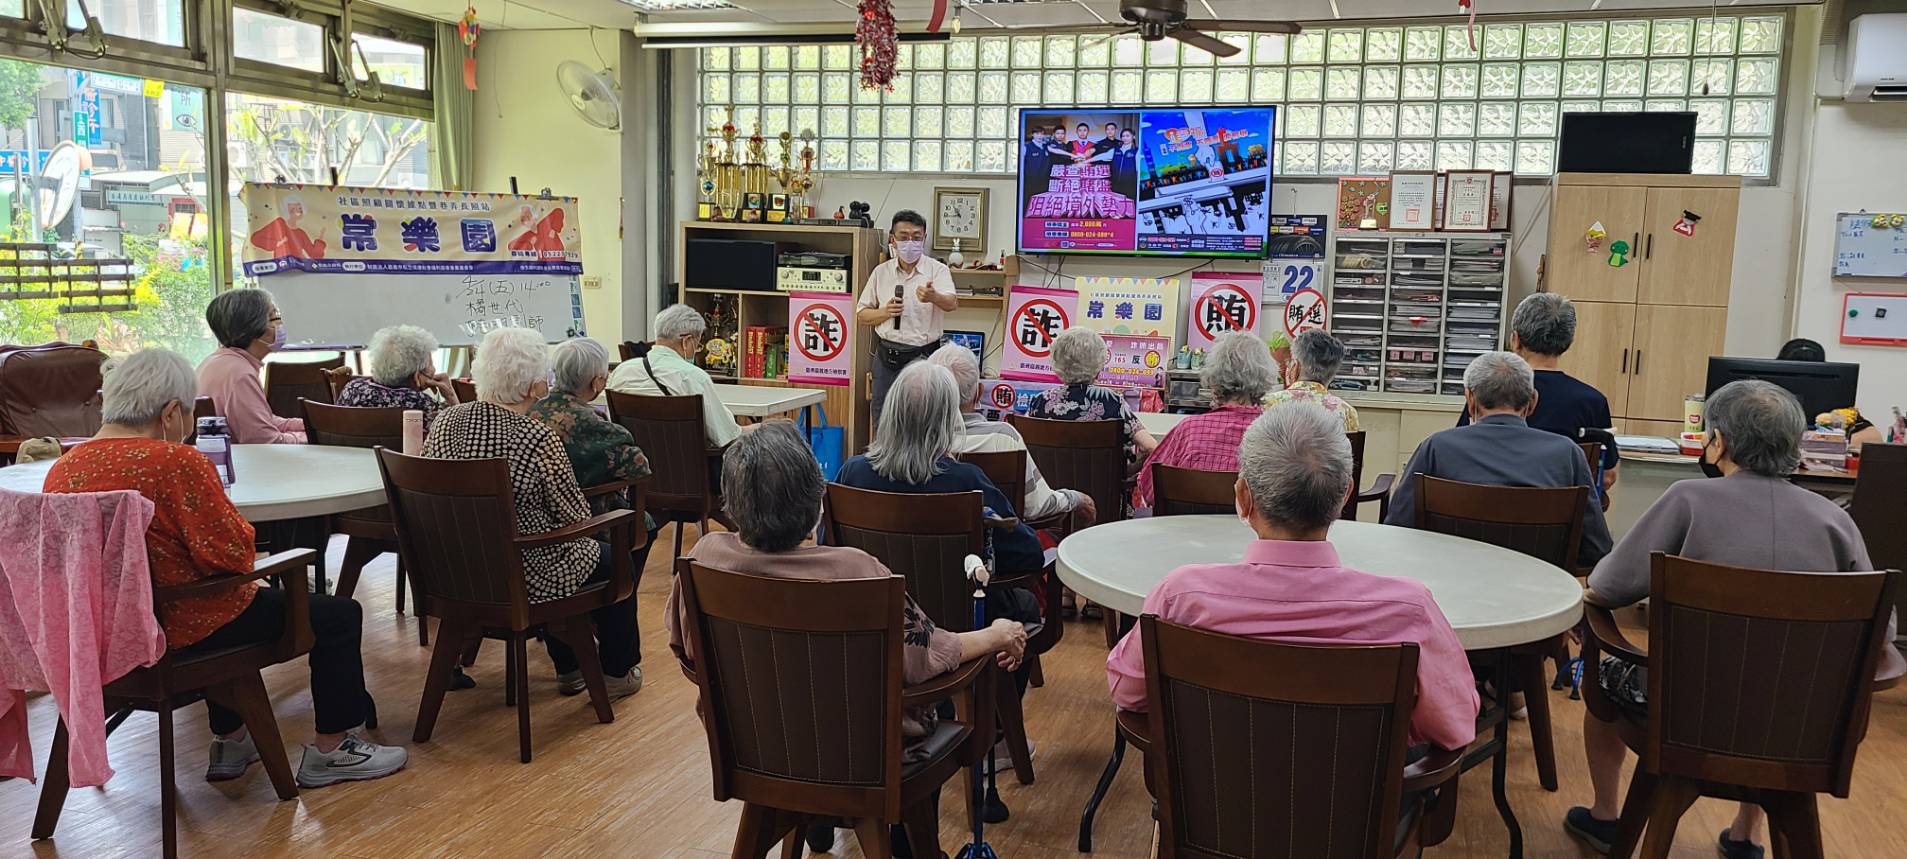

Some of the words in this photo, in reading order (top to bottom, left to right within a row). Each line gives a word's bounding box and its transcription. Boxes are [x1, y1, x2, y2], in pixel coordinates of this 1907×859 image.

[1027, 195, 1135, 217] 阻絕境外勢力
[341, 213, 497, 252] 常樂園
[1282, 265, 1314, 293] 22
[1087, 300, 1162, 321] 常樂園
[1206, 294, 1247, 332] 賄
[1288, 304, 1323, 324] 賄選
[804, 312, 839, 352] 詐
[1022, 307, 1061, 347] 詐
[1132, 355, 1141, 364] 反
